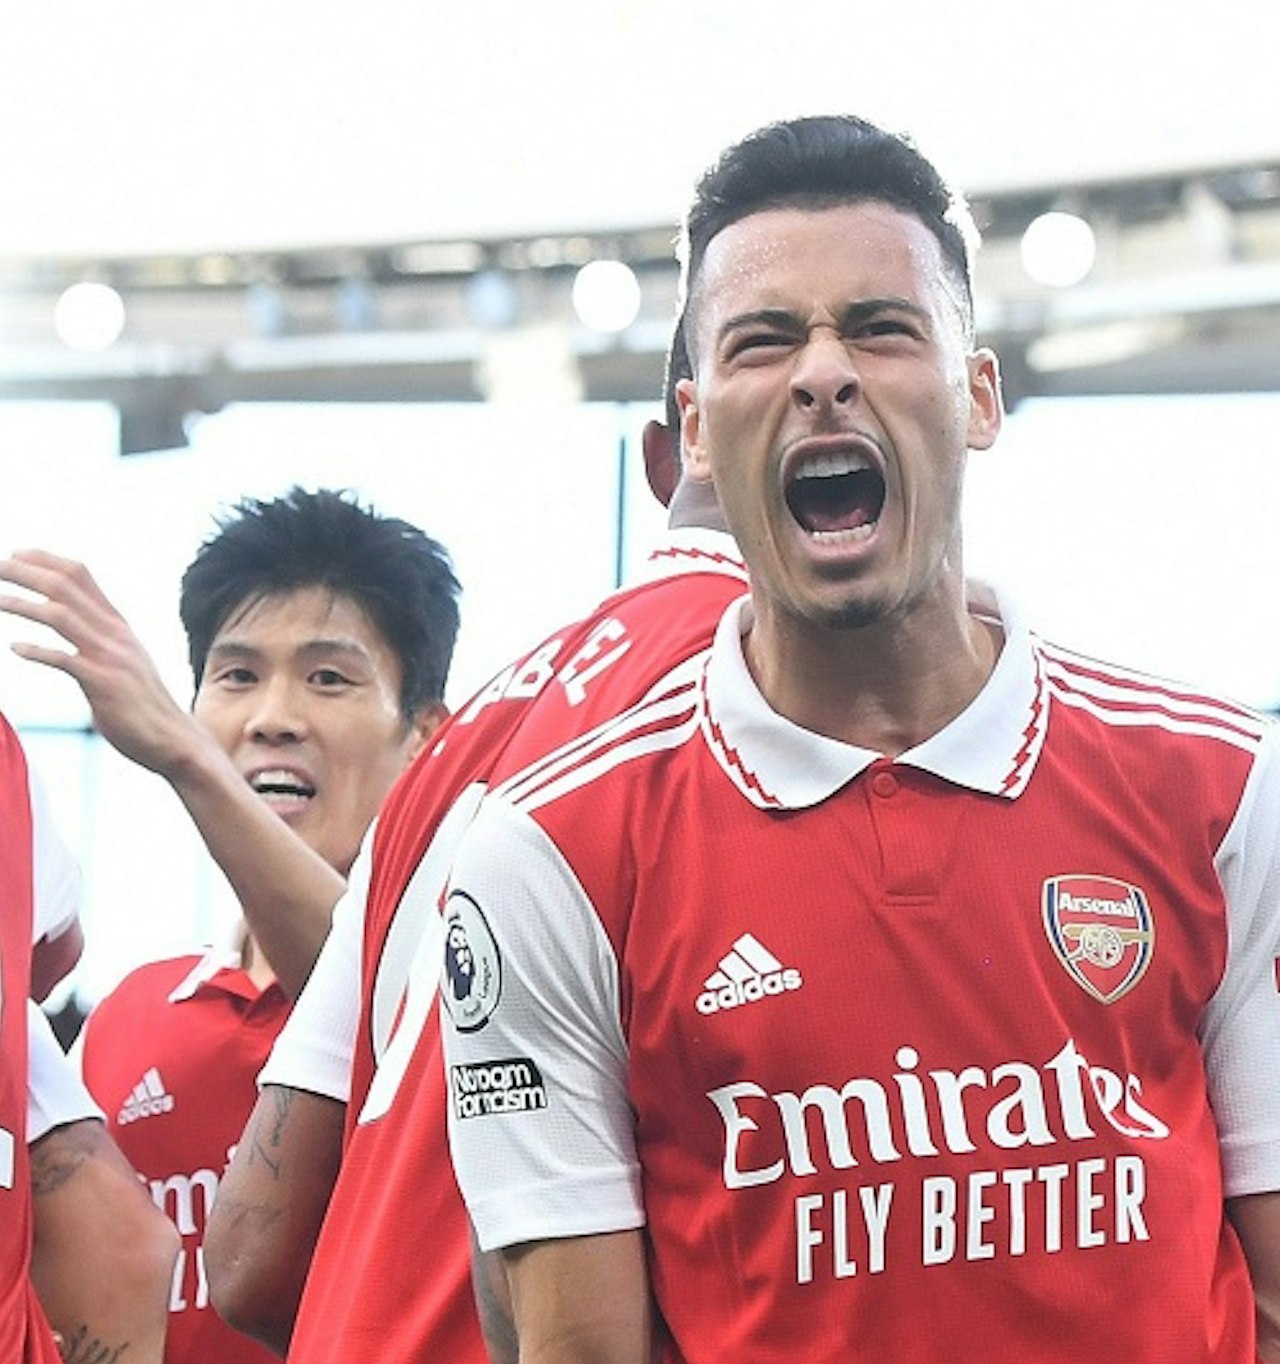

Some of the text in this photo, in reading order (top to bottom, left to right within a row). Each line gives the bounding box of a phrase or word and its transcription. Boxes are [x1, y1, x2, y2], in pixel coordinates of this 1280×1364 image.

[1060, 892, 1136, 917] Arsenal
[695, 968, 803, 1015] adidas
[706, 1038, 1170, 1190] Emirates
[795, 1155, 1150, 1284] FLY BETTER
